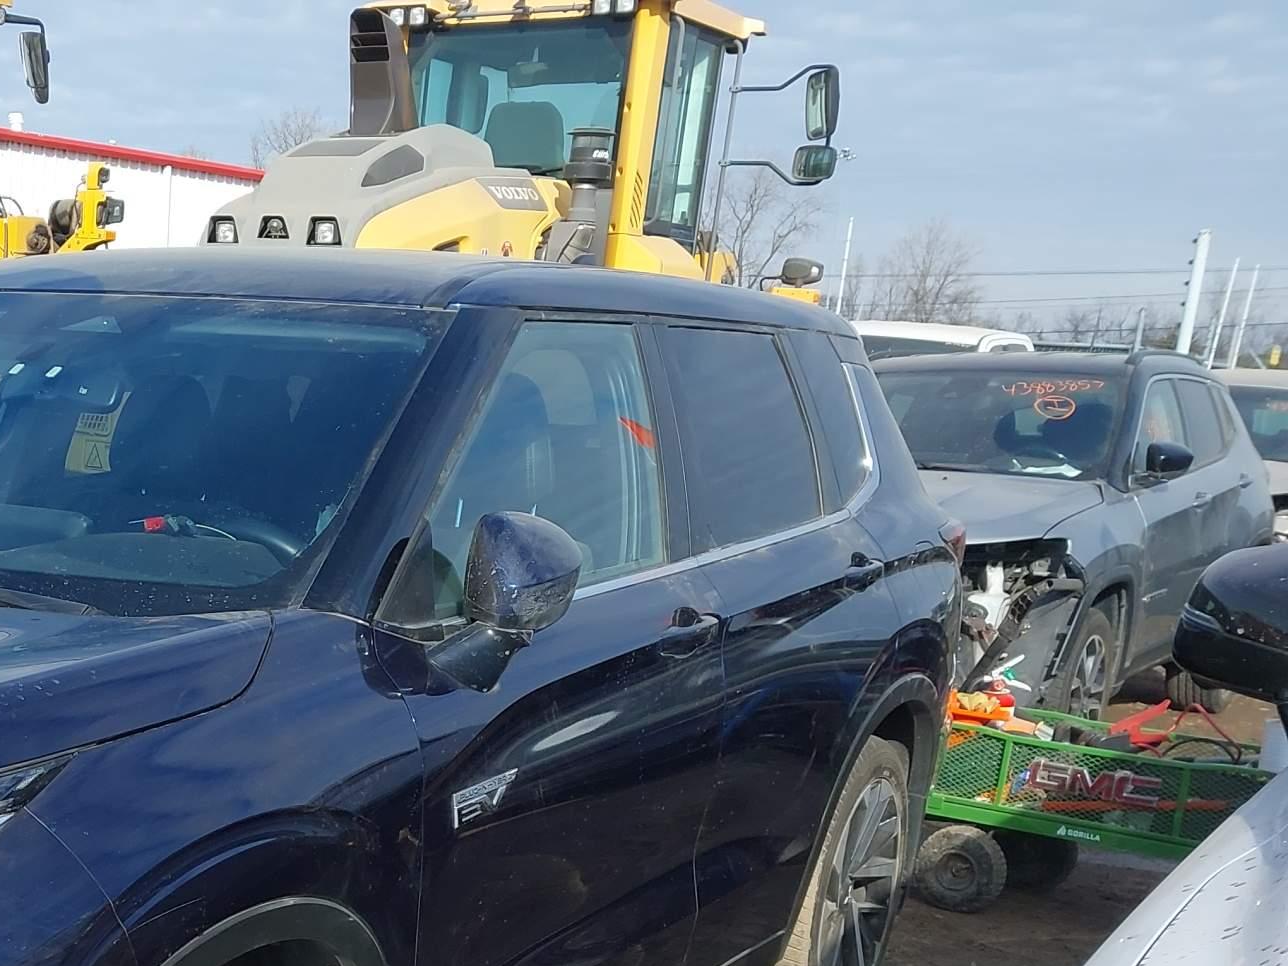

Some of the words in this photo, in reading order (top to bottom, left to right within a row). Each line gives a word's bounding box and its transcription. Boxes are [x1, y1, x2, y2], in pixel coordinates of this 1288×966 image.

[488, 185, 540, 201] VOLVO
[1027, 757, 1163, 808] GMC
[1067, 829, 1101, 842] GORILLA
